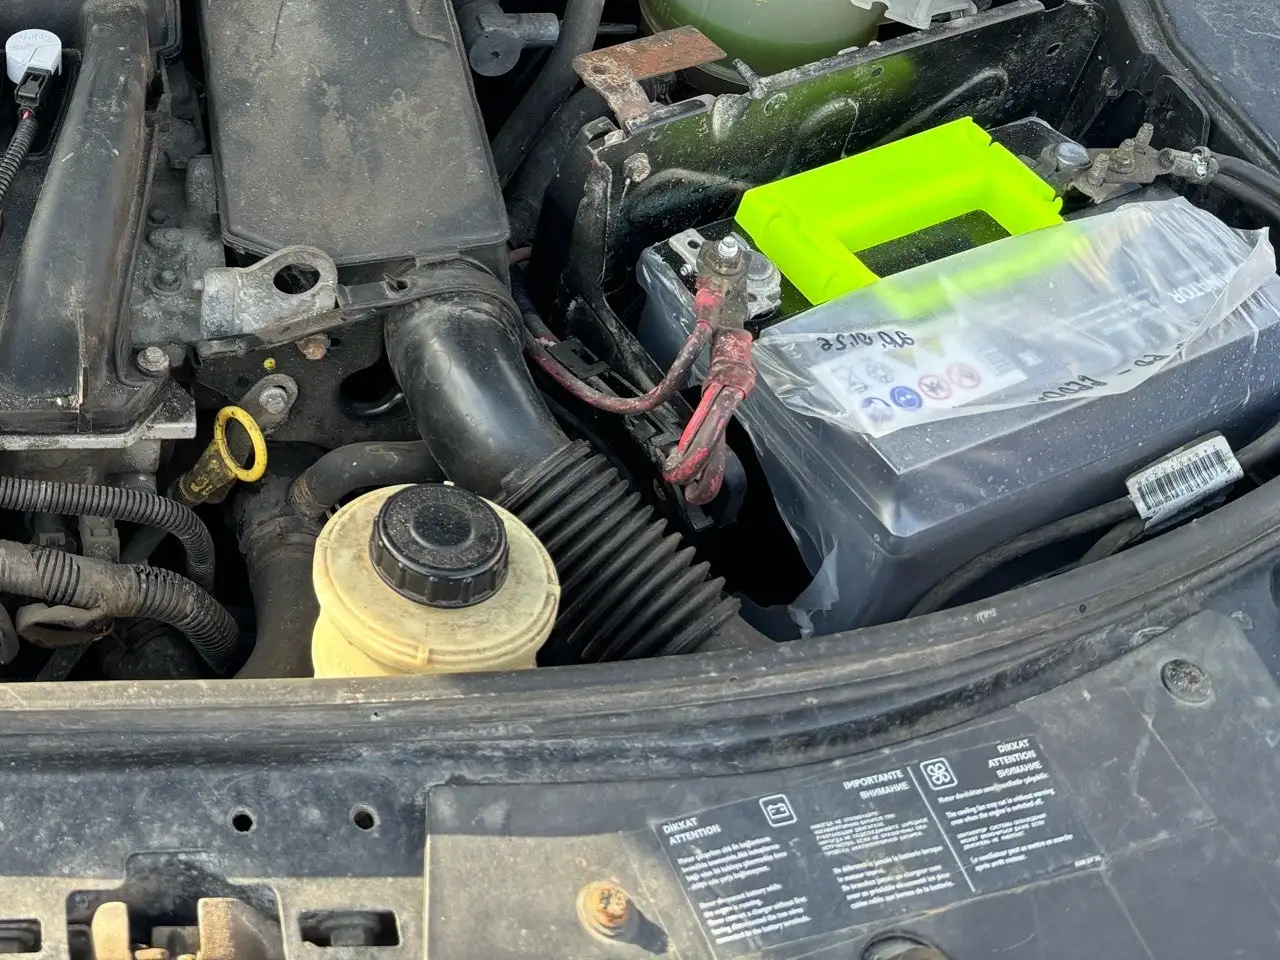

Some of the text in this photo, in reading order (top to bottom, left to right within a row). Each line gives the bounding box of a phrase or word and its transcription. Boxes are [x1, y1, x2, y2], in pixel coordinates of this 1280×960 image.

[988, 750, 1037, 768] ATTENTION
[996, 760, 1043, 779] ВНИМАНИЕ
[843, 769, 904, 790] IMPORTANTE
[859, 781, 911, 800] ВНИМАНИЕ
[669, 824, 722, 846] ATTENTION
